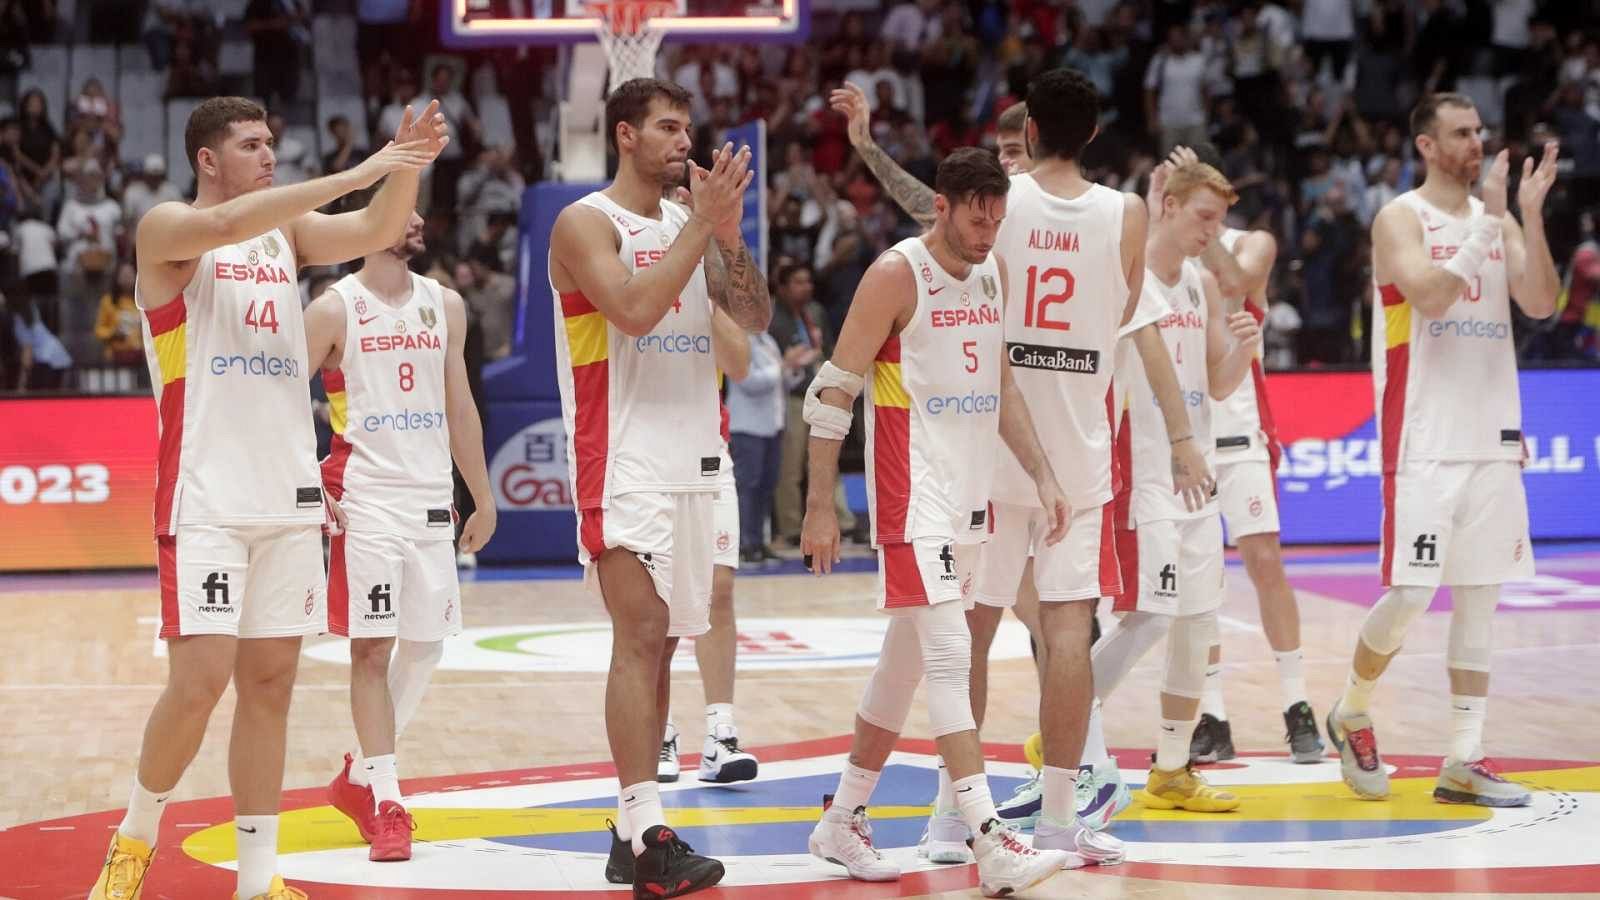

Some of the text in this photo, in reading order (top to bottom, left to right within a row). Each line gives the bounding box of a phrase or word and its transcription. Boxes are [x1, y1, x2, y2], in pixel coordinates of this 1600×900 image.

[1028, 228, 1080, 252] ALDAMA
[1024, 265, 1075, 331] 12
[245, 299, 279, 335] 44
[931, 304, 1000, 328] ESPAÑA
[1158, 311, 1203, 329] SPAÑA
[1428, 315, 1508, 340] endesa
[360, 331, 441, 353] ESPAÑA
[962, 341, 979, 374] 5
[1009, 345, 1096, 371] CaixaBank
[398, 362, 415, 392] 8
[363, 408, 444, 433] endesa
[0, 463, 110, 506] 023
[1413, 534, 1437, 561] fi
[202, 572, 230, 605] fi
[1160, 563, 1176, 591] fi
[368, 583, 391, 612] fi
[364, 611, 396, 621] network
